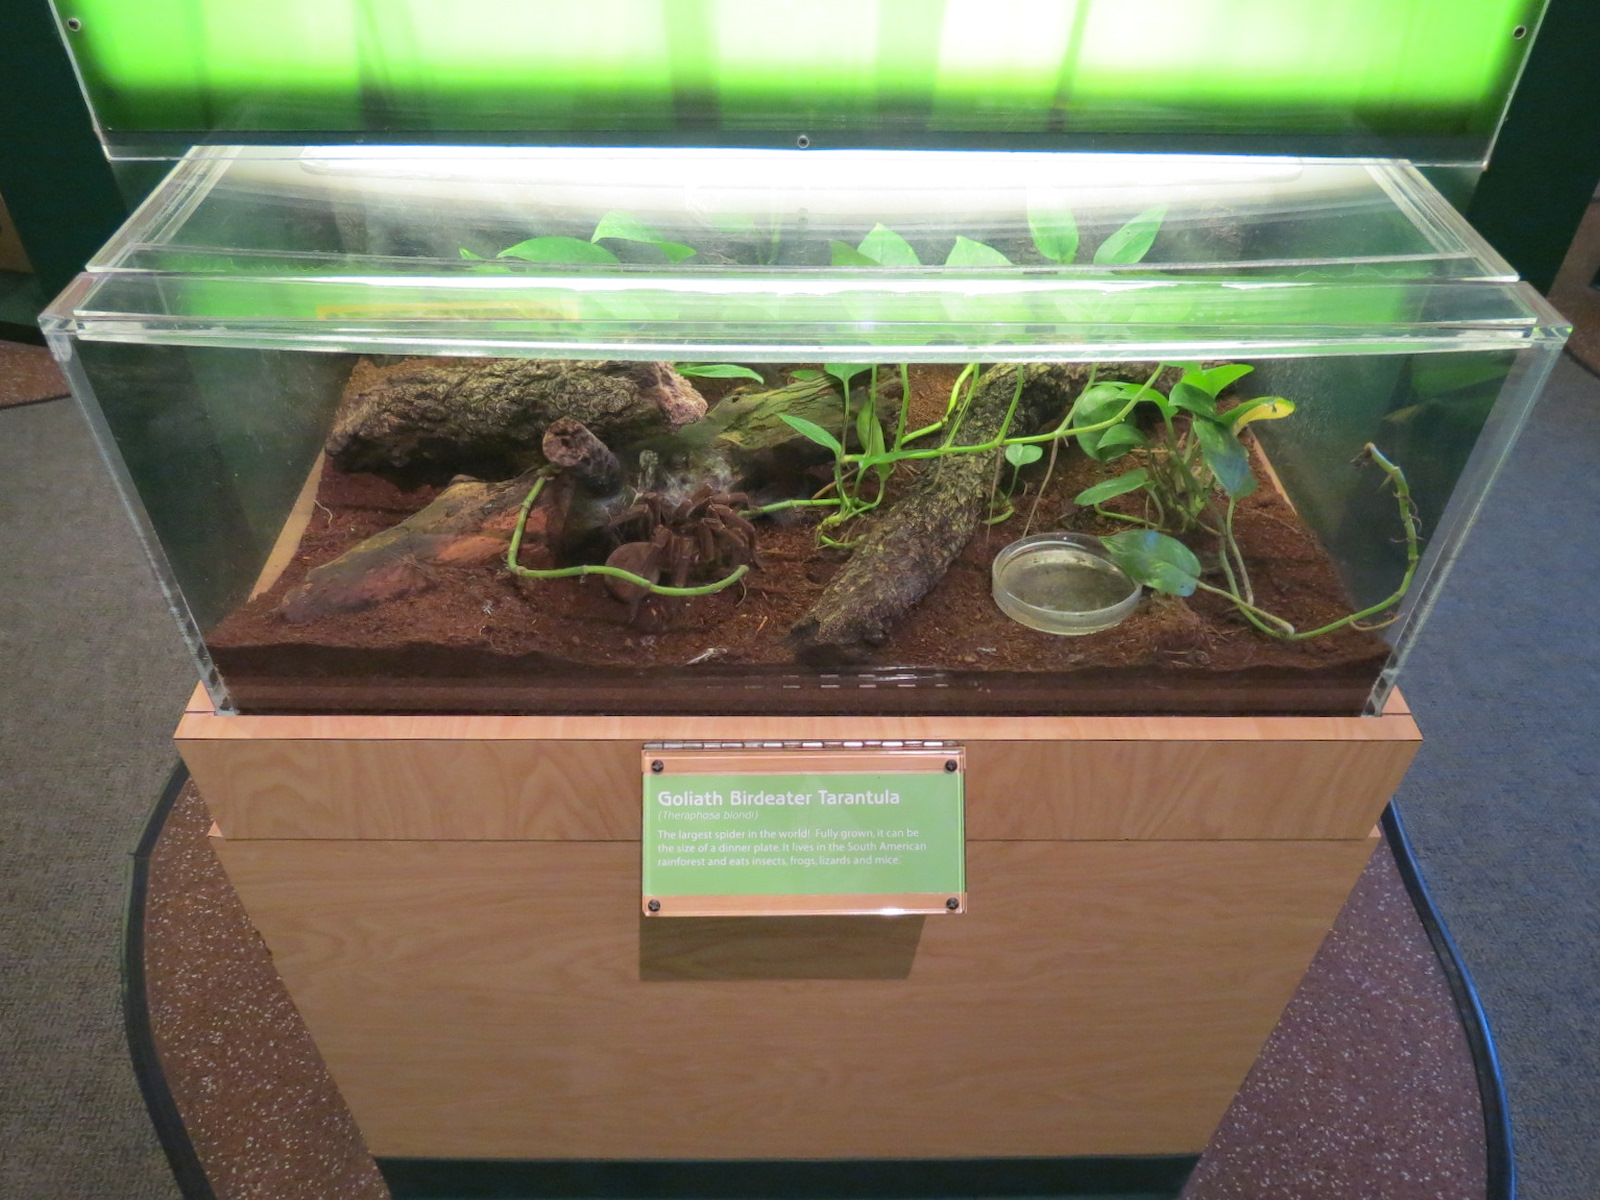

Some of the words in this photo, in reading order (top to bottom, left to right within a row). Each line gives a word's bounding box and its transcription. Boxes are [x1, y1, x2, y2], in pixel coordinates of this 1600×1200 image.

[657, 791, 723, 806] Goliath
[730, 790, 812, 806] Birdeater
[818, 789, 900, 805] Tarantula
[658, 810, 720, 821] (Theraphosa
[658, 830, 676, 839] The
[678, 830, 712, 841] largest
[715, 829, 745, 841] spider
[748, 829, 757, 838] in
[760, 829, 776, 838] the
[779, 829, 810, 838] world!
[815, 829, 838, 840] Fully
[841, 830, 875, 840] grown,
[877, 828, 884, 837] it
[906, 828, 919, 837] be
[658, 843, 674, 853] the
[677, 843, 695, 853] size
[698, 842, 709, 853] of
[710, 845, 717, 853] a
[718, 843, 750, 853] dinner
[783, 843, 789, 852] It
[792, 843, 814, 852] lives
[817, 842, 826, 851] in
[829, 842, 844, 851] the
[848, 842, 877, 851] South
[879, 842, 927, 851] American
[658, 856, 705, 866] rainforest
[708, 856, 727, 866] and
[729, 857, 750, 866] eats
[752, 856, 788, 866] insects,
[790, 856, 818, 867] frogs,
[819, 855, 851, 865] lizards
[853, 855, 872, 864] and
[875, 856, 902, 864] mice.
